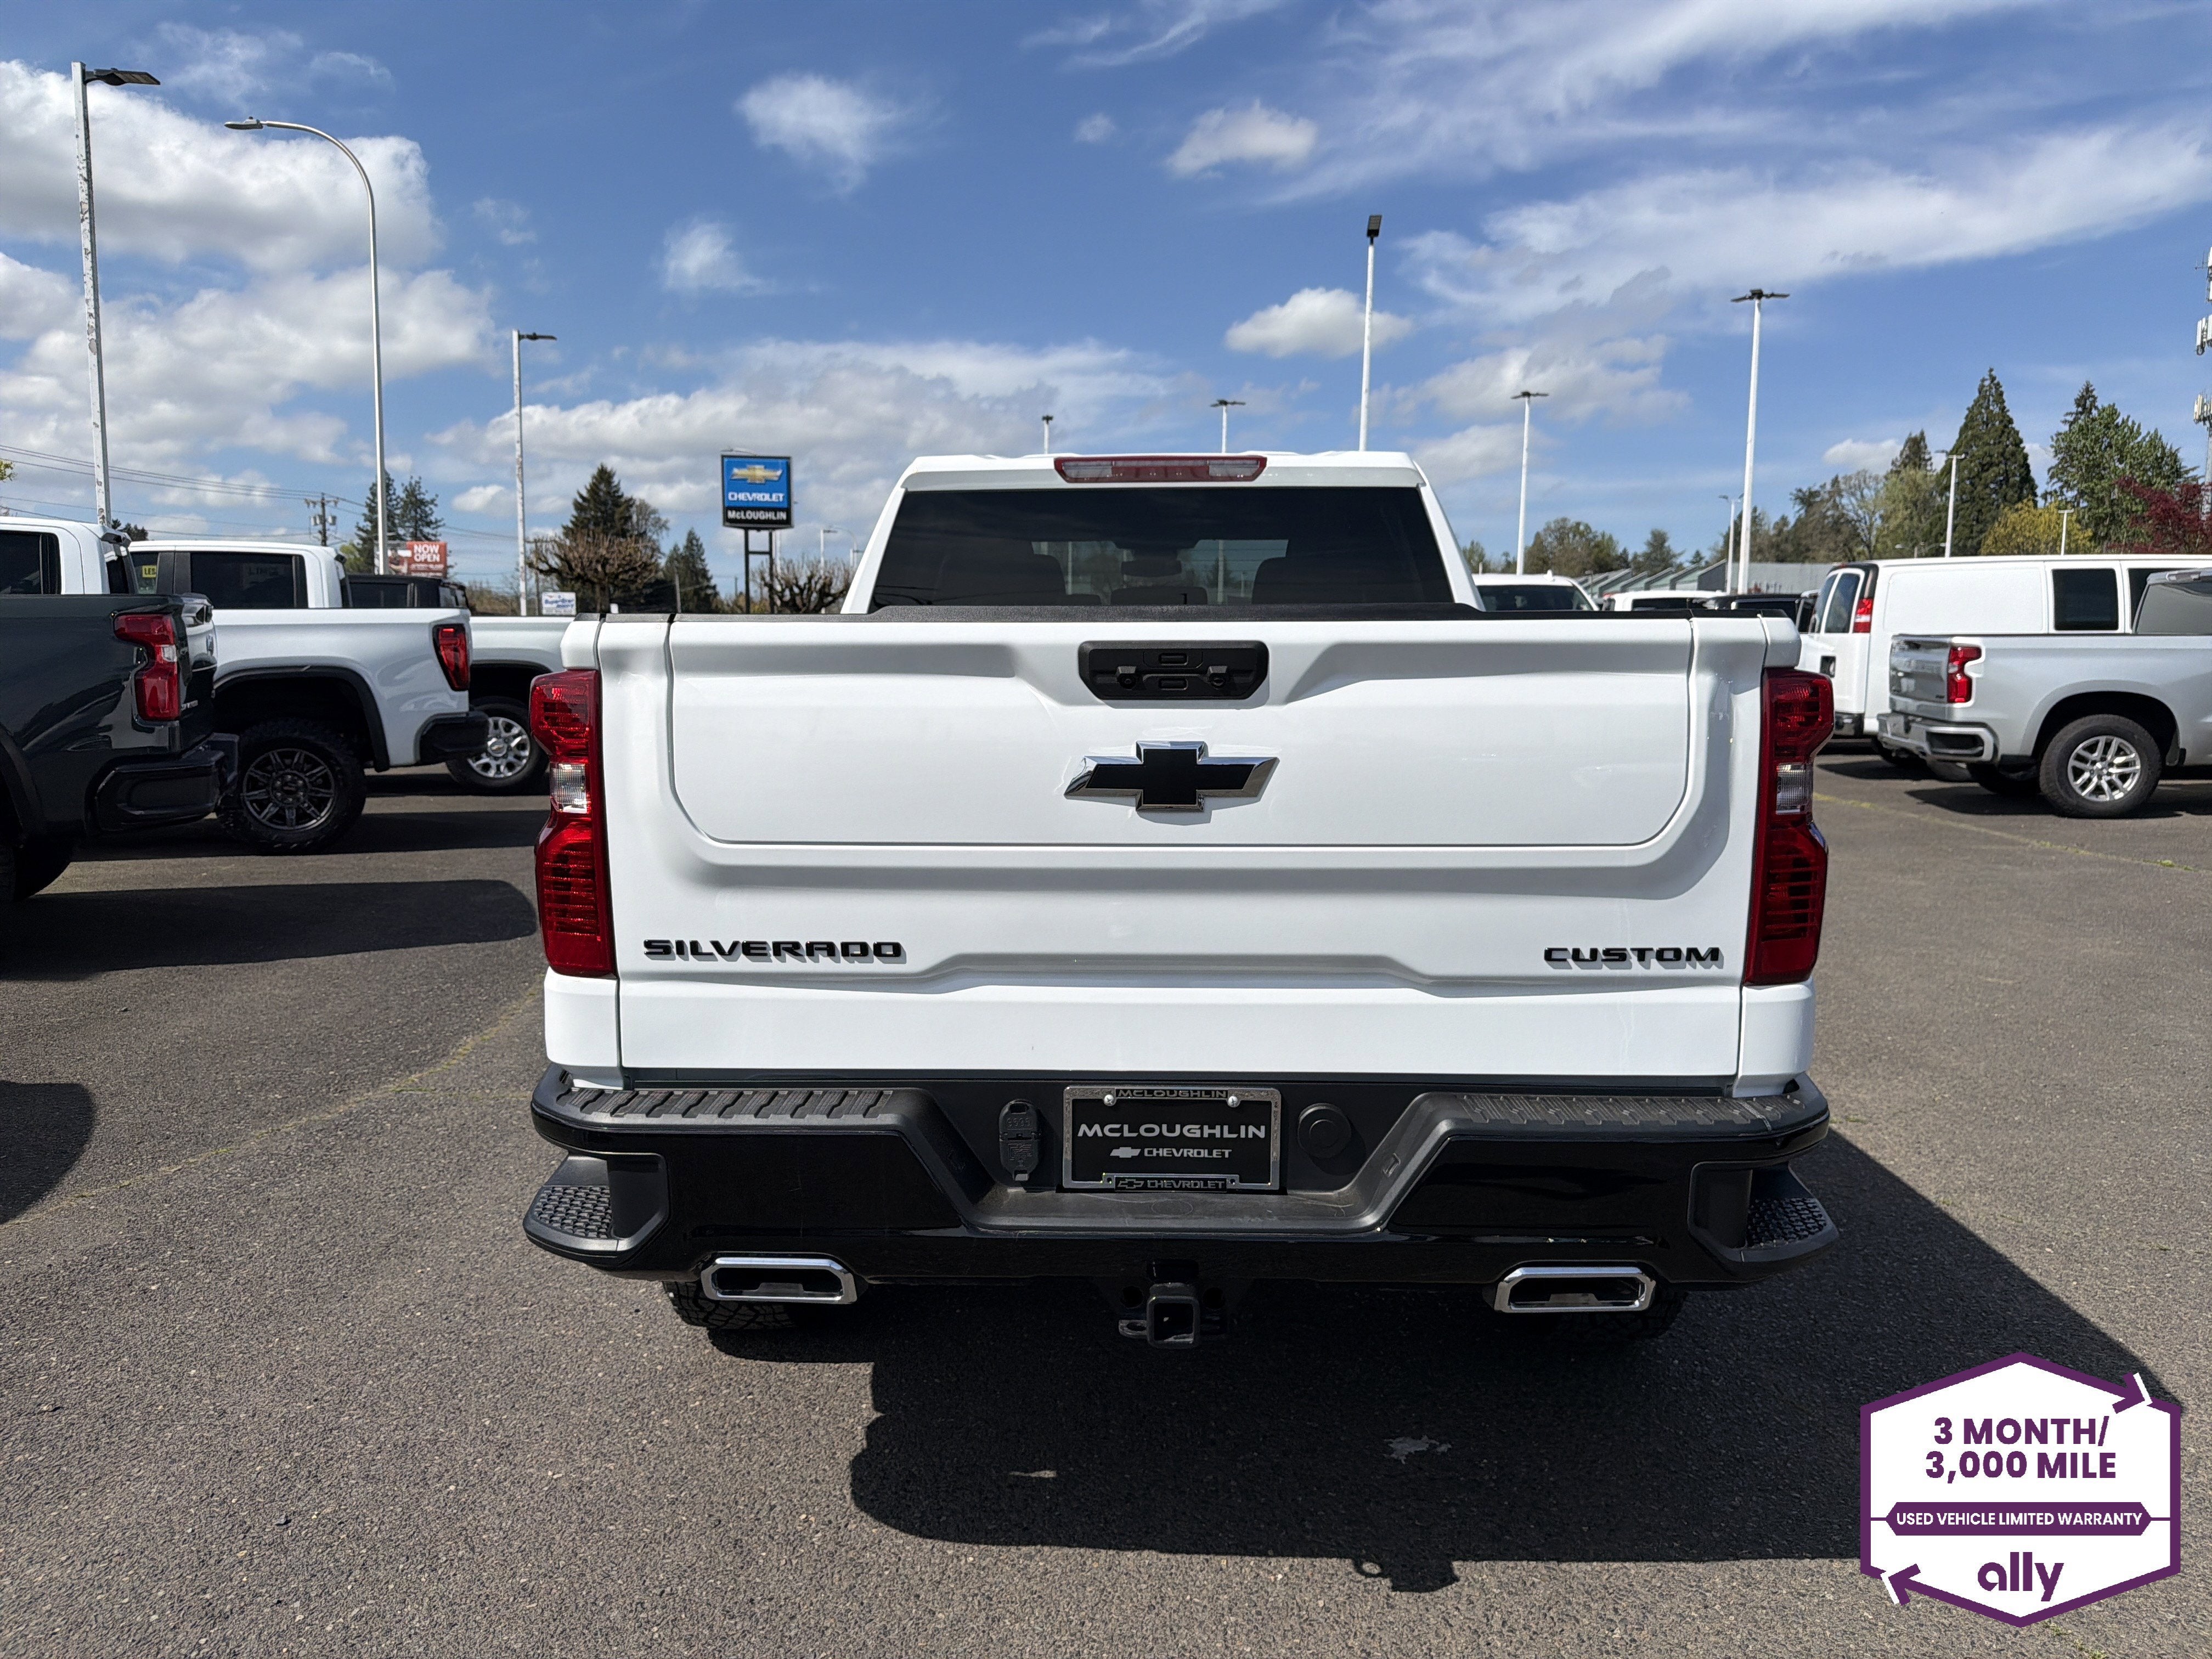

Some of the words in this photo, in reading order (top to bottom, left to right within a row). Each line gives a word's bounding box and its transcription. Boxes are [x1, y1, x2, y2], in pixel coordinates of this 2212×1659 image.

[728, 492, 785, 502] CHEVROLET
[727, 510, 787, 521] McLOUGHLIN
[413, 544, 439, 554] NOW
[414, 554, 440, 562] OPEN
[644, 939, 902, 957] SILVERADO
[1544, 947, 1720, 962] CUSTOM
[1118, 1088, 1227, 1098] MCLOUGHLIN
[1077, 1123, 1266, 1139] MCLOUGHLIN
[1144, 1148, 1232, 1159] CHEVROLET
[1147, 1180, 1225, 1189] CHEVROLET
